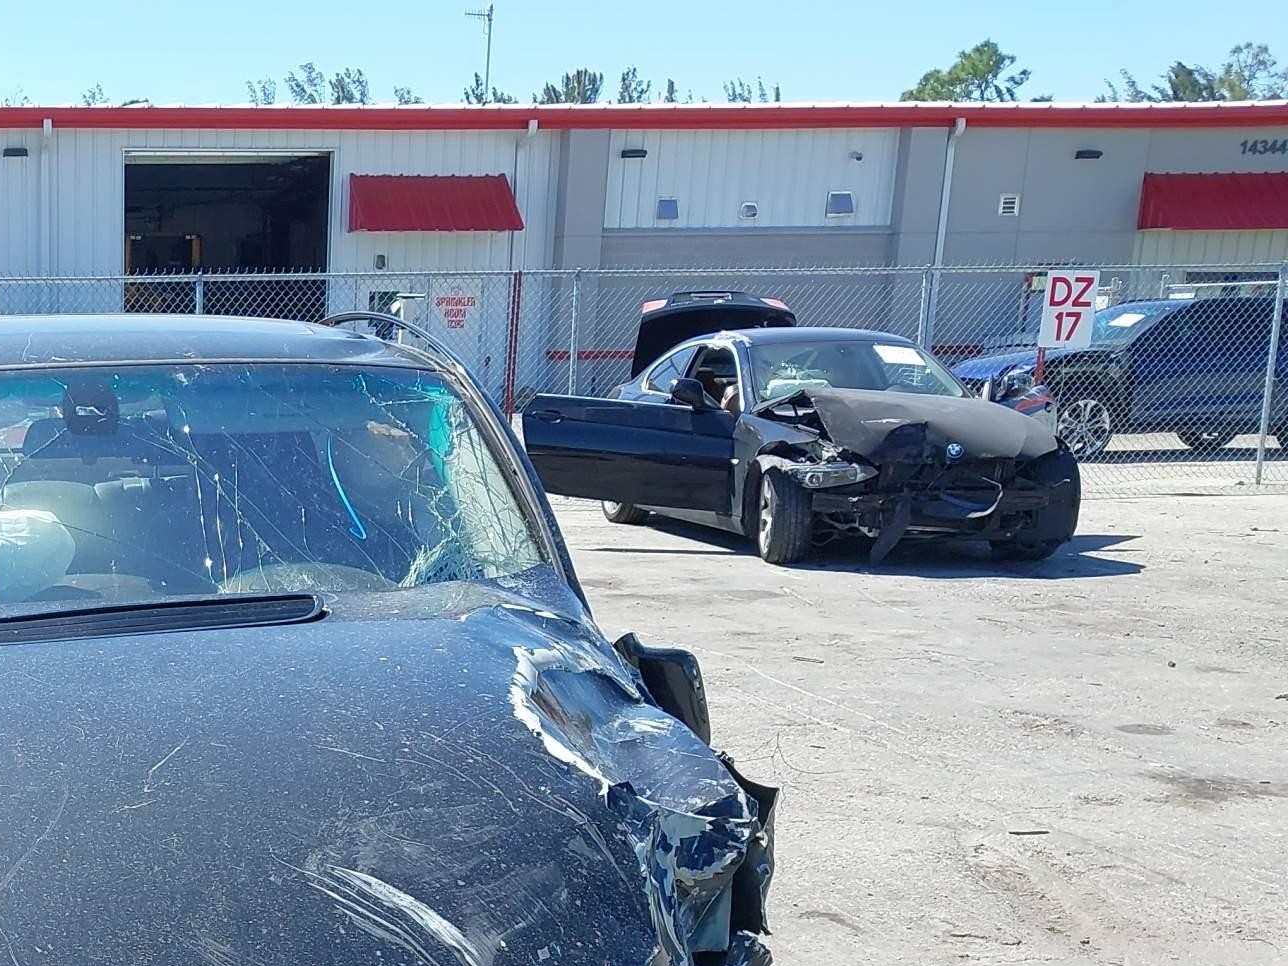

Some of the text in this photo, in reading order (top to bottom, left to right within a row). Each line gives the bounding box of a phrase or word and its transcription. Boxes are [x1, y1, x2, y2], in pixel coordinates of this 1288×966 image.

[1240, 140, 1288, 155] 14344
[1049, 277, 1095, 307] DZ
[435, 296, 476, 307] SPRINKLER
[444, 308, 466, 319] ROOM
[1055, 312, 1082, 341] 17
